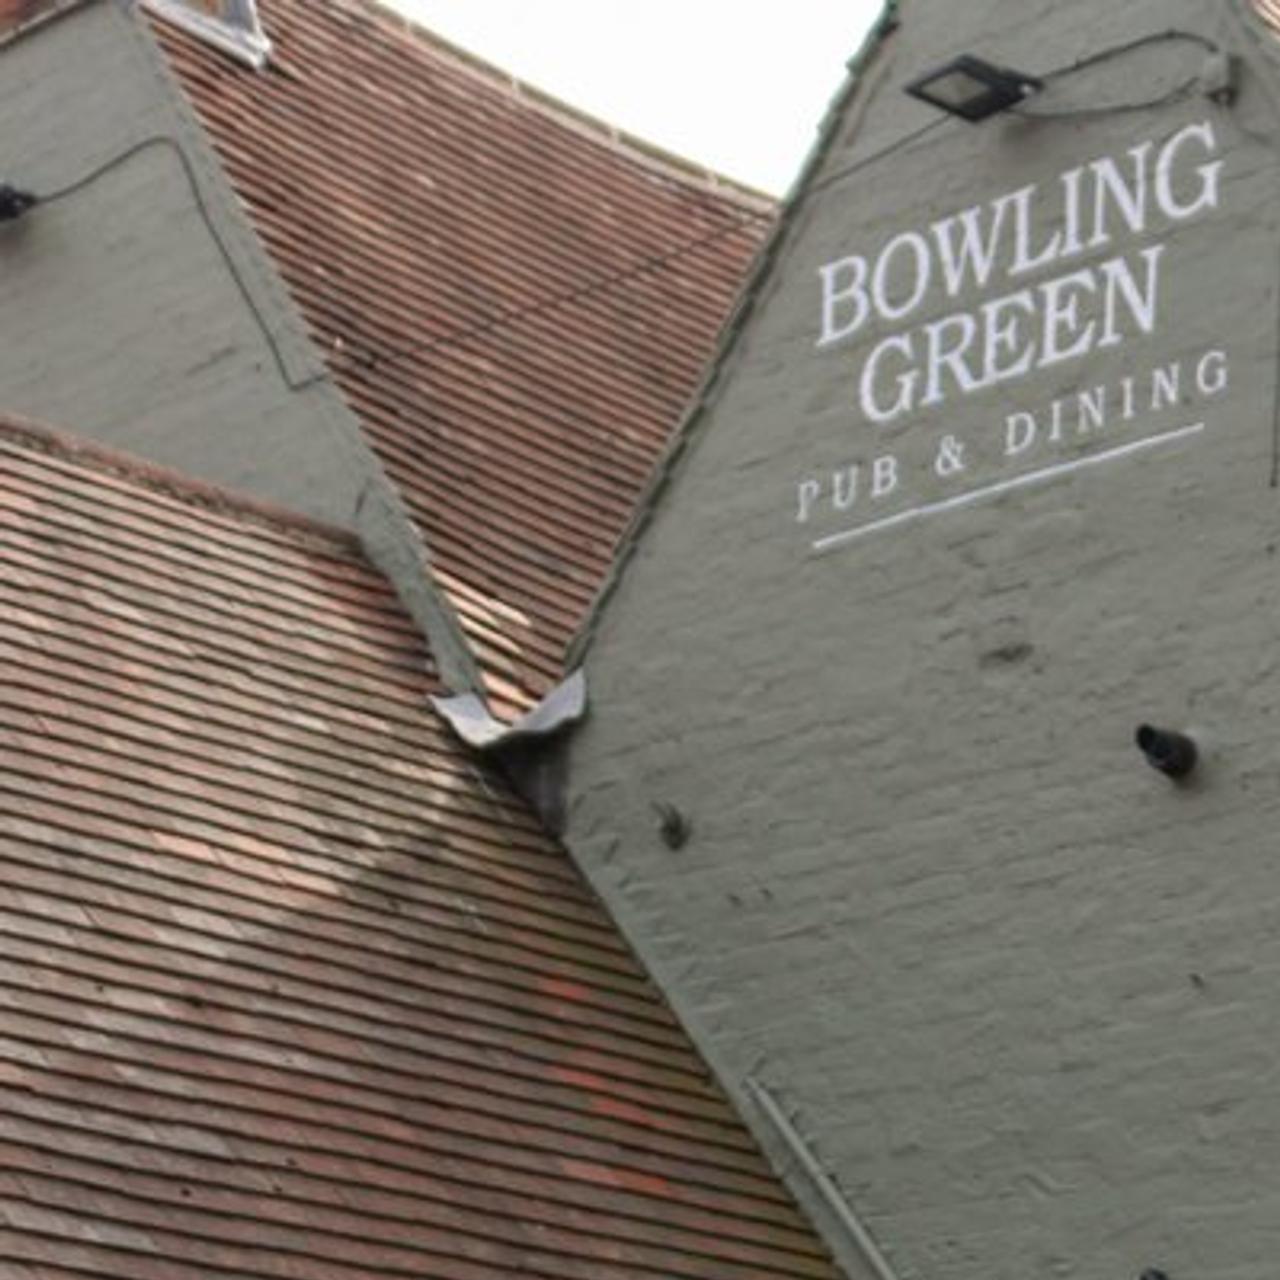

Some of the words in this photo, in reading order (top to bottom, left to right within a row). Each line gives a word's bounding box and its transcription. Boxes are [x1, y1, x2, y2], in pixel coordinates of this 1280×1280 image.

[815, 120, 1225, 348] BOWLING
[858, 243, 1166, 423] GREEN
[795, 454, 898, 522] PUB
[934, 434, 965, 475] &
[1005, 350, 1229, 456] DINING
